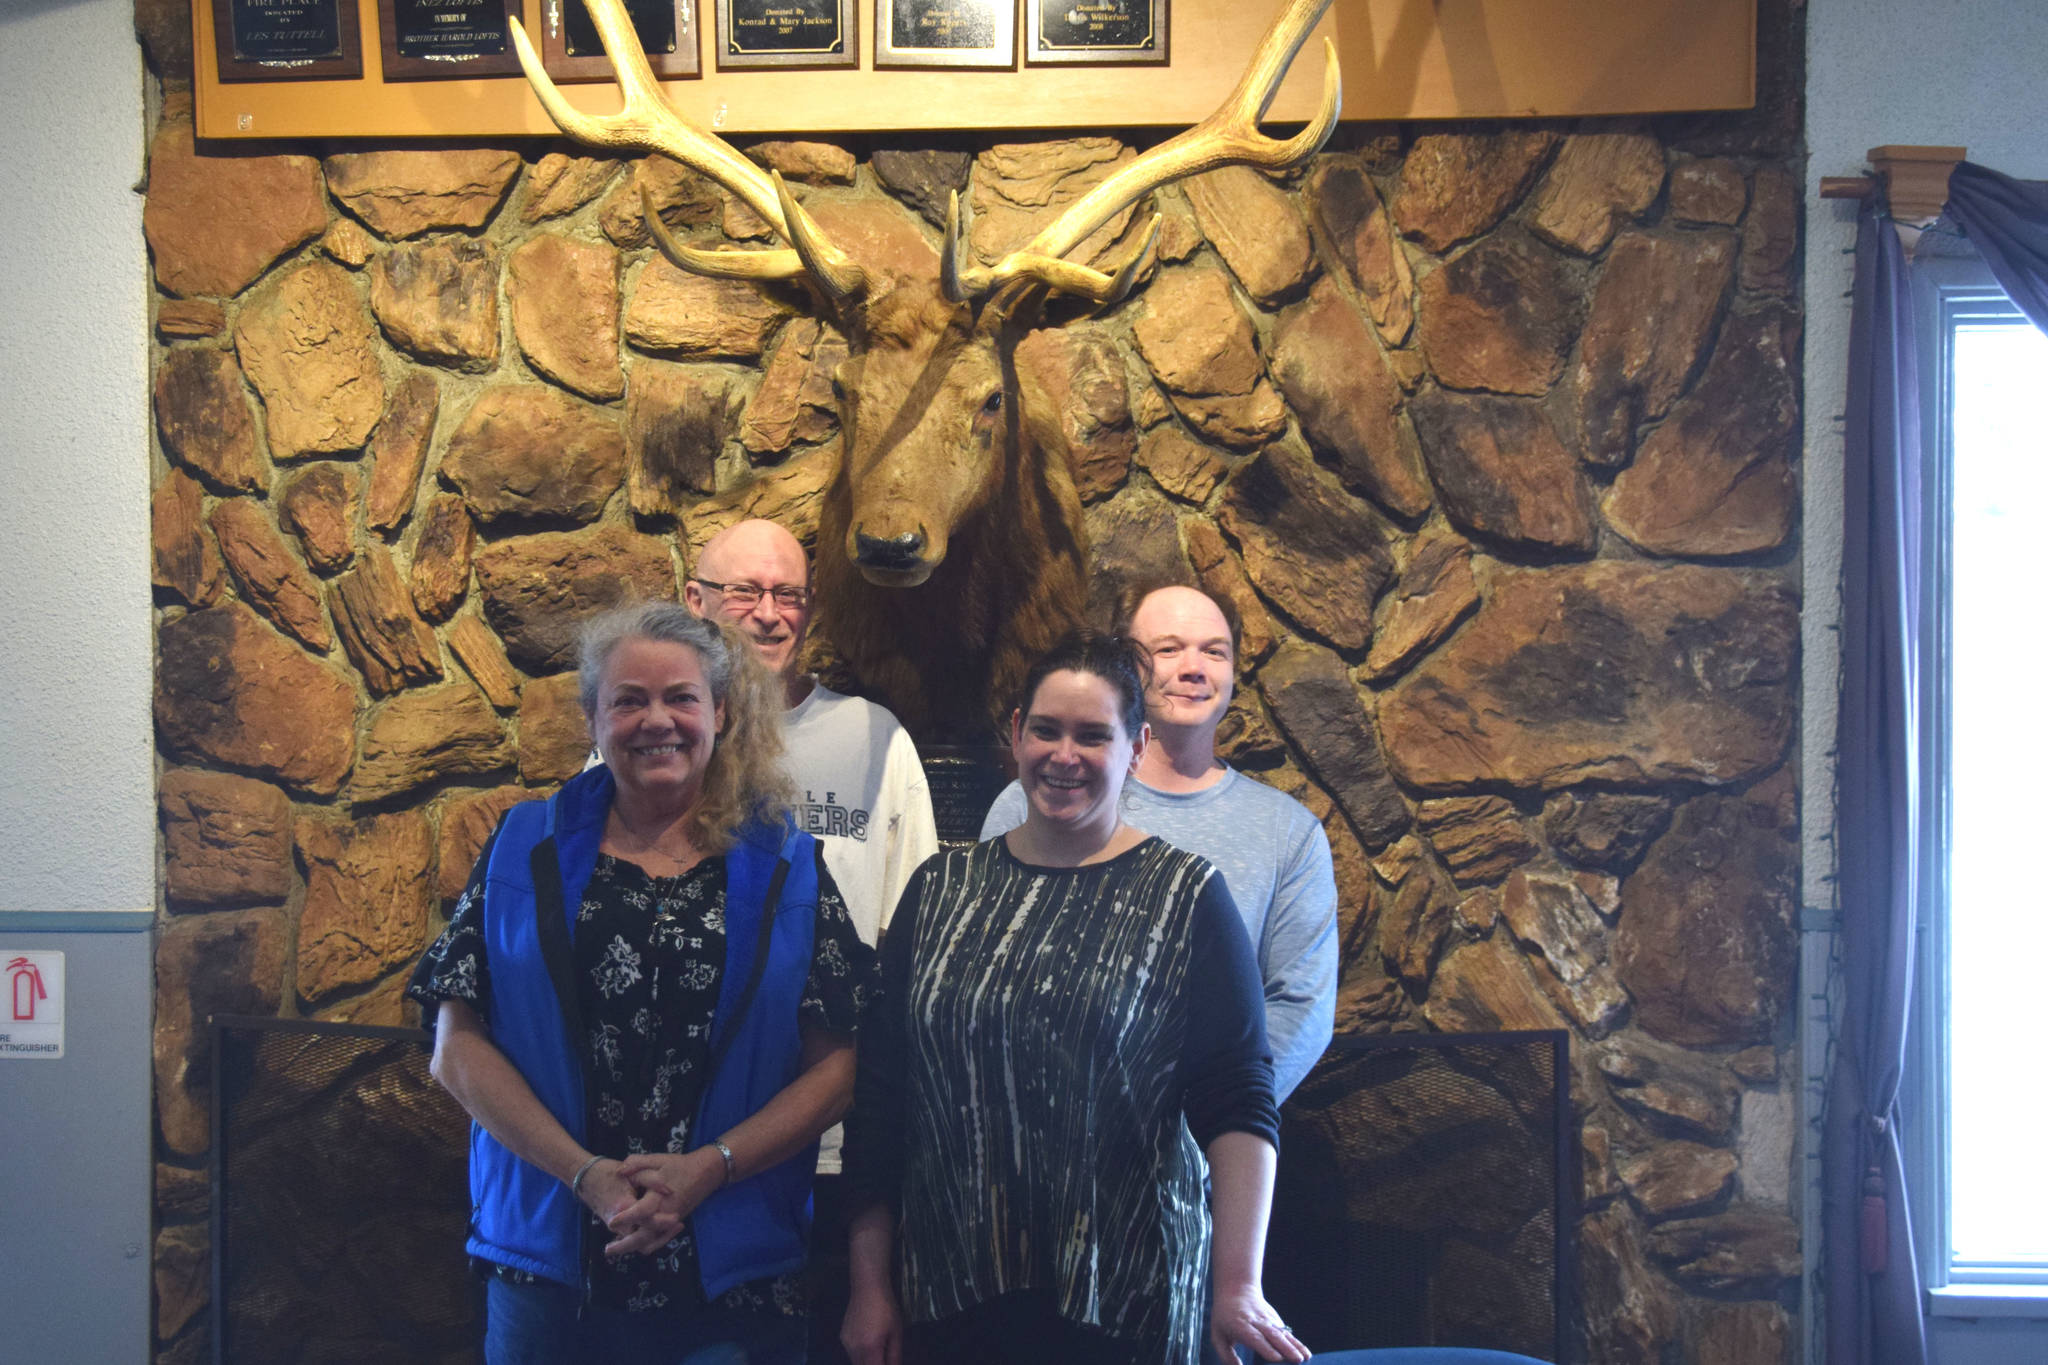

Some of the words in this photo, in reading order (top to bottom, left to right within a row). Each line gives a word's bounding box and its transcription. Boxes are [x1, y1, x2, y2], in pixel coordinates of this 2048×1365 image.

[795, 8, 805, 16] By
[738, 18, 766, 26] Konrad
[769, 17, 776, 26] &
[779, 17, 800, 26] Mary
[803, 17, 832, 25] Jackson
[403, 34, 440, 43] BROTHER
[441, 33, 474, 42] HAROLD
